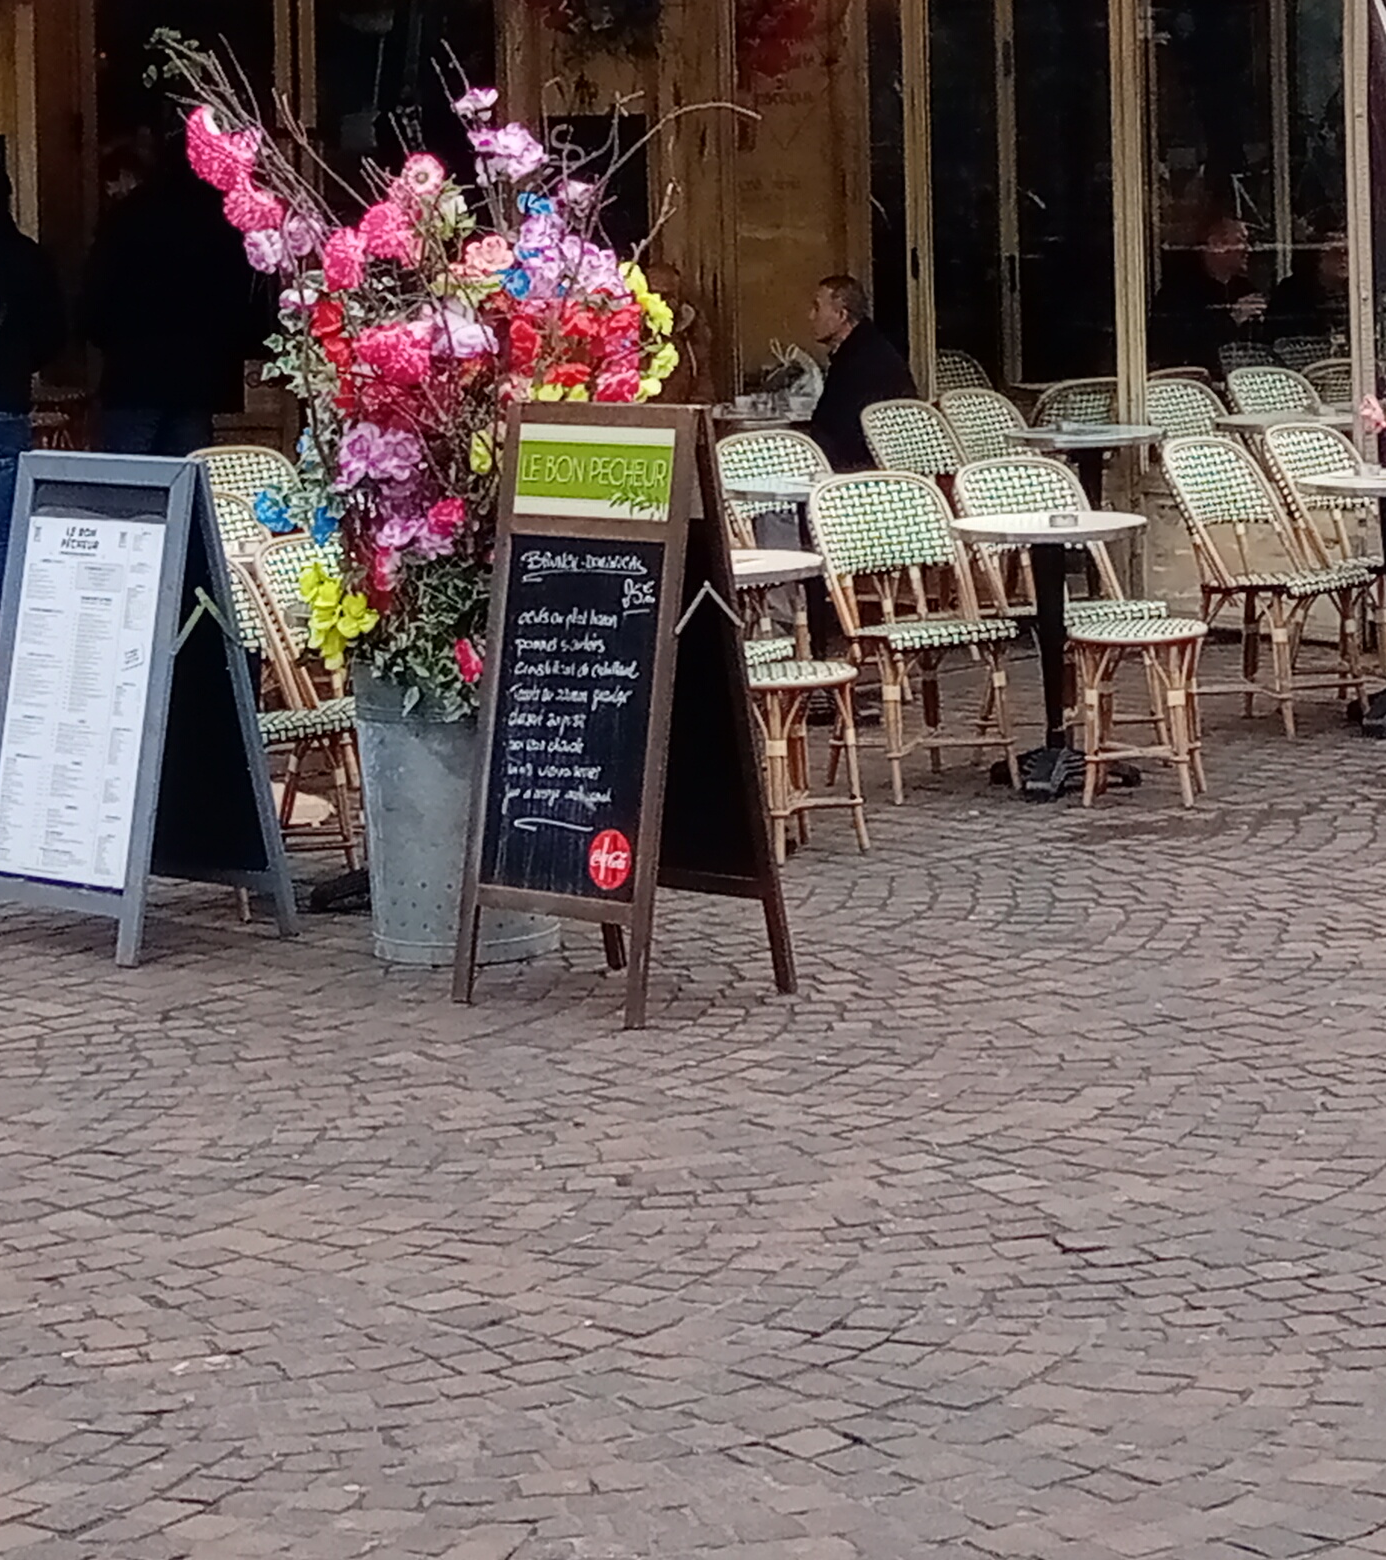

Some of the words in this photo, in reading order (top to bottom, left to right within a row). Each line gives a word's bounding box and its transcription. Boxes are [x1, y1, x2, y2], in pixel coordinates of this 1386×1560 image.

[521, 454, 542, 481] LE
[544, 455, 585, 483] BON
[588, 457, 668, 488] PECHEUR
